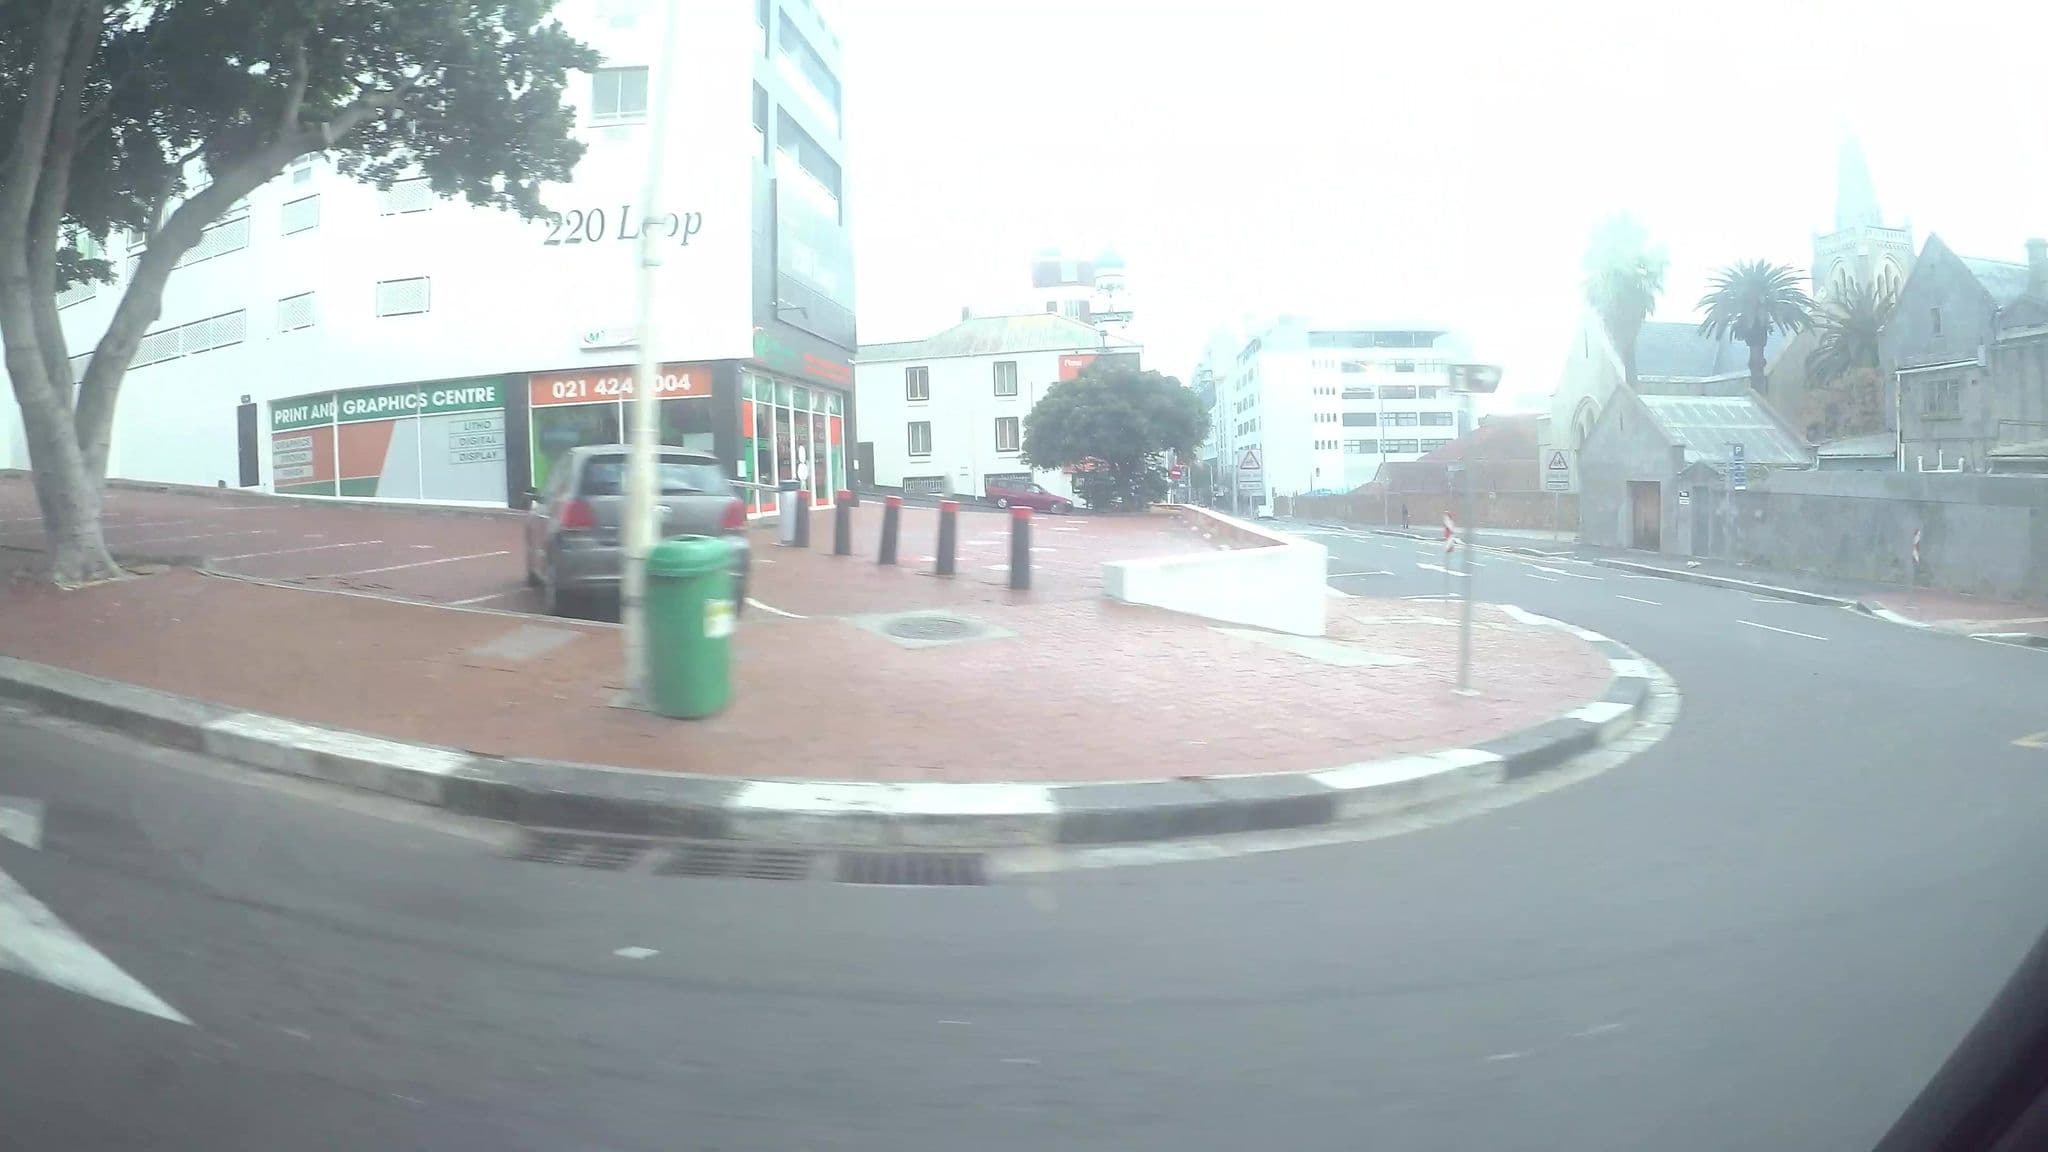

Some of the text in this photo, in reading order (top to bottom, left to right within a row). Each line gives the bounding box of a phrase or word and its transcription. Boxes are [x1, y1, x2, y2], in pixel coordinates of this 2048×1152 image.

[544, 208, 605, 245] 220
[552, 380, 587, 398] 021
[594, 378, 634, 396] 424
[275, 386, 495, 424] PRINT AND GRAPHICS CENTRE
[464, 420, 492, 431] LITHO
[459, 435, 496, 446] DIGITAL
[459, 450, 497, 461] DISPLAY
